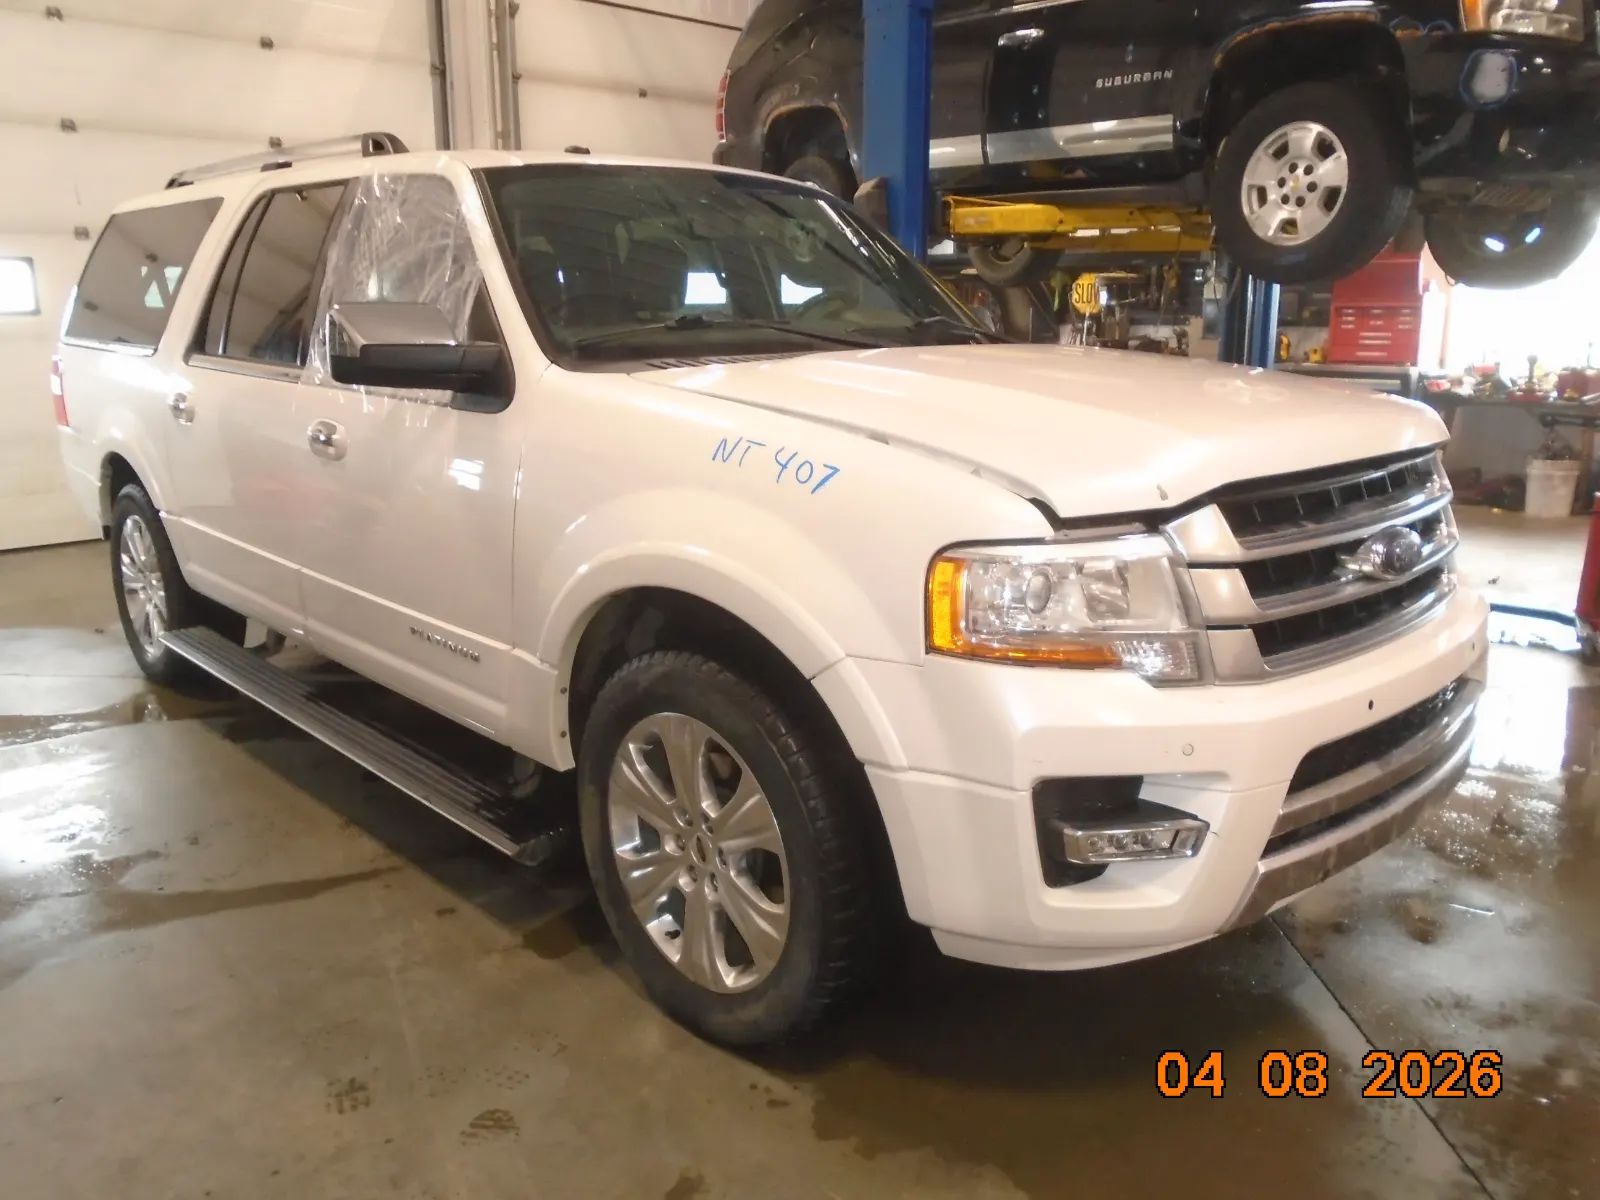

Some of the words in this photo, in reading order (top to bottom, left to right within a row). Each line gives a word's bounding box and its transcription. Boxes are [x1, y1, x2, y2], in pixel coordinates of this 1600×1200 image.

[1096, 70, 1173, 88] SUBURBAN
[712, 436, 766, 467] NT
[774, 446, 840, 494] 407
